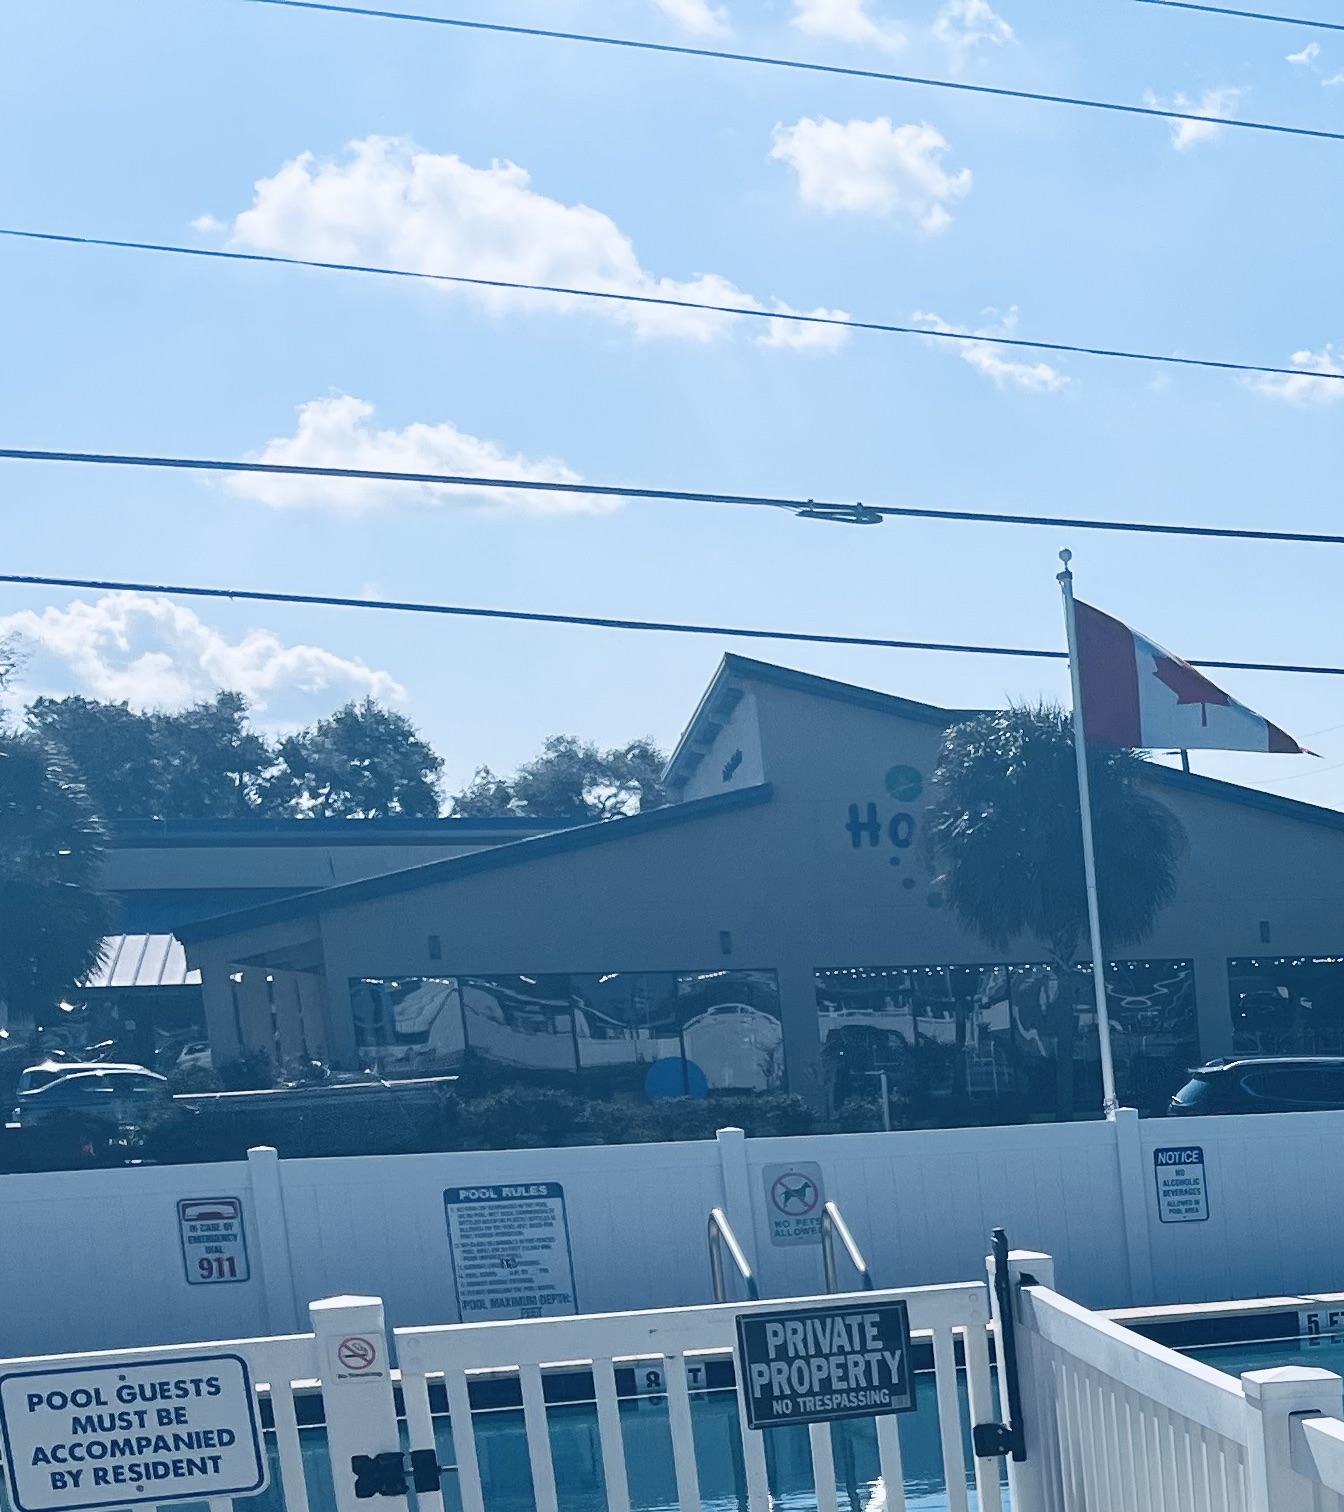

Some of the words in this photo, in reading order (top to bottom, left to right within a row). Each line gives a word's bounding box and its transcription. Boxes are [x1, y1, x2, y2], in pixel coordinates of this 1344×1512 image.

[1158, 1150, 1199, 1164] NOTICE
[1162, 1178, 1200, 1187] ALCOHOLIC
[1175, 1169, 1185, 1177] NO
[459, 1188, 497, 1200] POOL
[502, 1185, 548, 1197] RULES
[774, 1219, 790, 1228] NO
[796, 1217, 821, 1227] PETS
[198, 1256, 237, 1279] 911
[1307, 1313, 1319, 1334] 5
[765, 1313, 883, 1359] PRIVATE
[750, 1350, 901, 1398] PROPERTY
[27, 1387, 108, 1412] POOL
[116, 1377, 221, 1404] GUESTS
[772, 1399, 792, 1415] NO
[799, 1389, 890, 1413] TRESPASSING
[72, 1409, 147, 1435] MUST
[156, 1406, 188, 1427] BE
[32, 1428, 236, 1466] ACCOMPANIED
[50, 1469, 83, 1490] BY
[93, 1455, 222, 1486] RESIDENT
